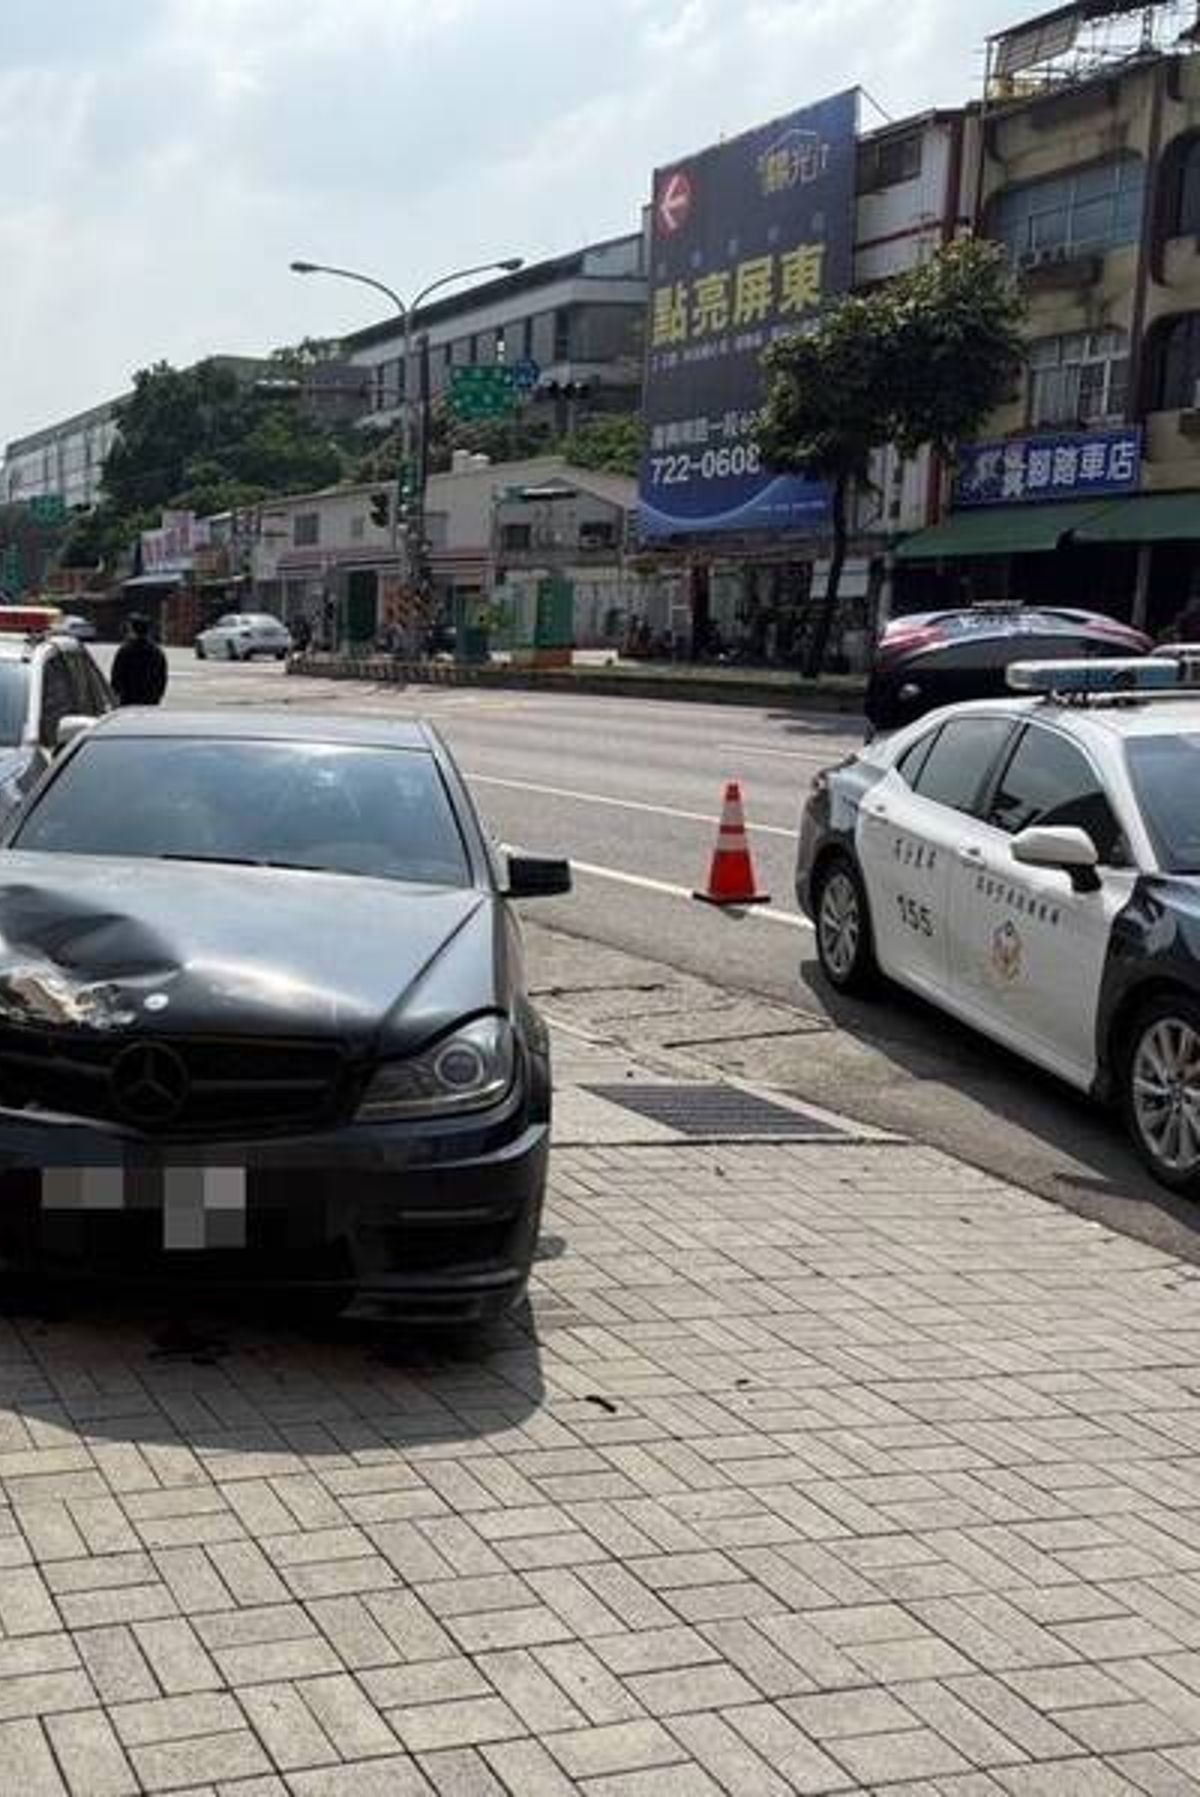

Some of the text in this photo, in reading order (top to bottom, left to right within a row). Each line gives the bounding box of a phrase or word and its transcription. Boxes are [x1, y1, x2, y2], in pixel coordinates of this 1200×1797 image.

[652, 243, 825, 346] 點亮屏東
[896, 894, 933, 937] 155
